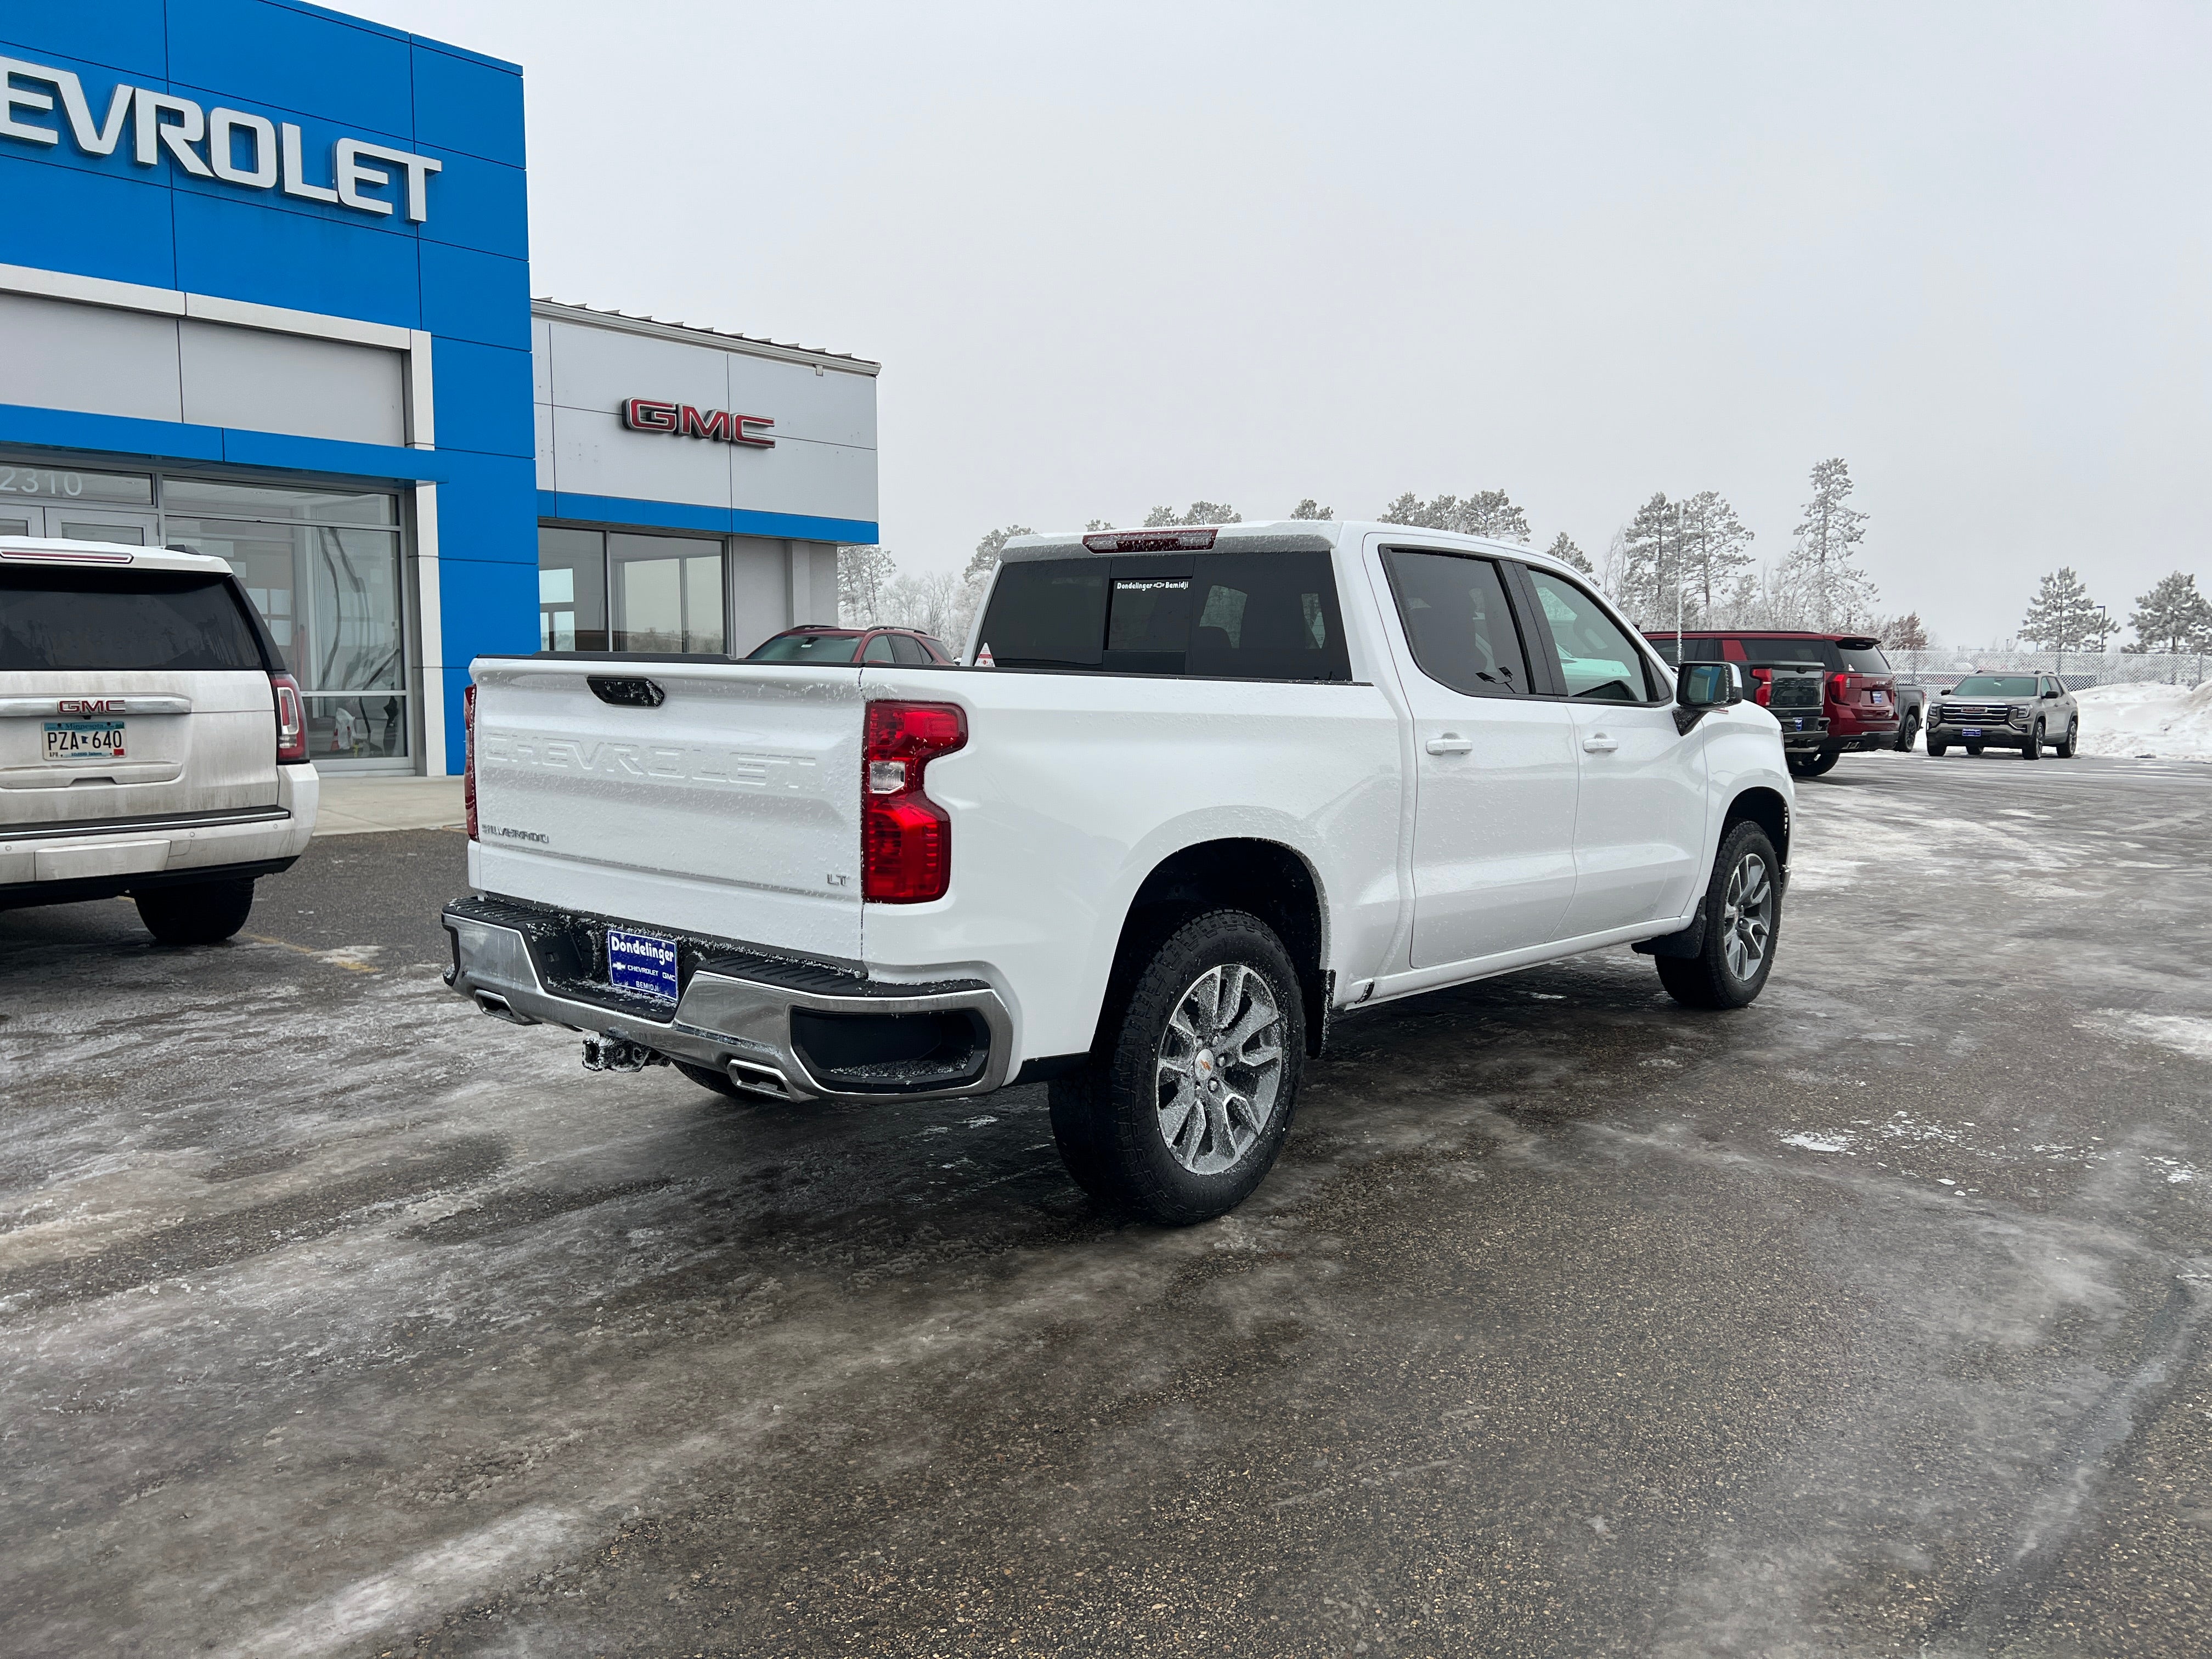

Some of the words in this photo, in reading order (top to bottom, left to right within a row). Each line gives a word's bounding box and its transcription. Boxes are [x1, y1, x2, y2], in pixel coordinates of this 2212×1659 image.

[0, 55, 442, 222] EVROLET
[622, 397, 775, 449] GMC
[0, 466, 82, 496] 2310
[1117, 582, 1153, 591] Dondelinger
[1165, 582, 1189, 590] Bemidji
[57, 699, 126, 713] GMC
[48, 731, 79, 751] PZA
[92, 730, 122, 748] 640
[487, 731, 816, 789] CHEVROLET
[827, 873, 847, 886] LT
[611, 935, 674, 966] Dondelinger
[627, 965, 659, 976] CHEVROLET
[662, 972, 676, 982] GMC
[635, 980, 659, 992] BEMIDJI
